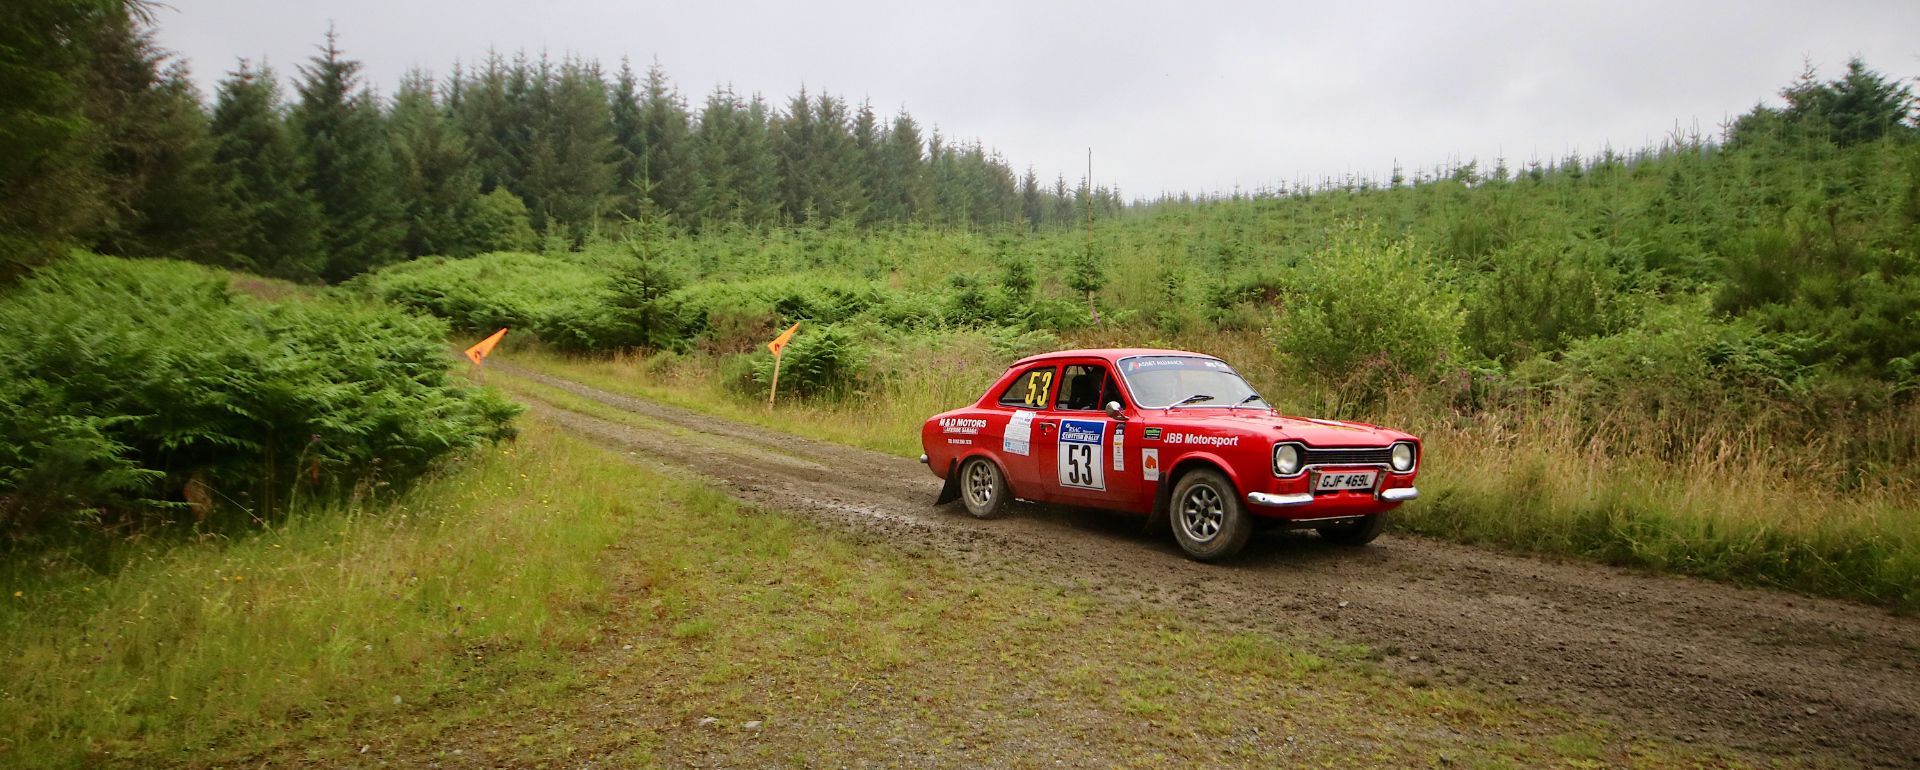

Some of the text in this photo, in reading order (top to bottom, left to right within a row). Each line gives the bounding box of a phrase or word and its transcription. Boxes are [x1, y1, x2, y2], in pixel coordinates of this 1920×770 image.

[1025, 371, 1052, 406] 53
[939, 418, 987, 428] M & D MOTORS
[1163, 432, 1183, 444] JBB
[1184, 433, 1239, 448] Motorsport
[1069, 444, 1092, 485] 53
[1322, 474, 1369, 487] GJF 469L
